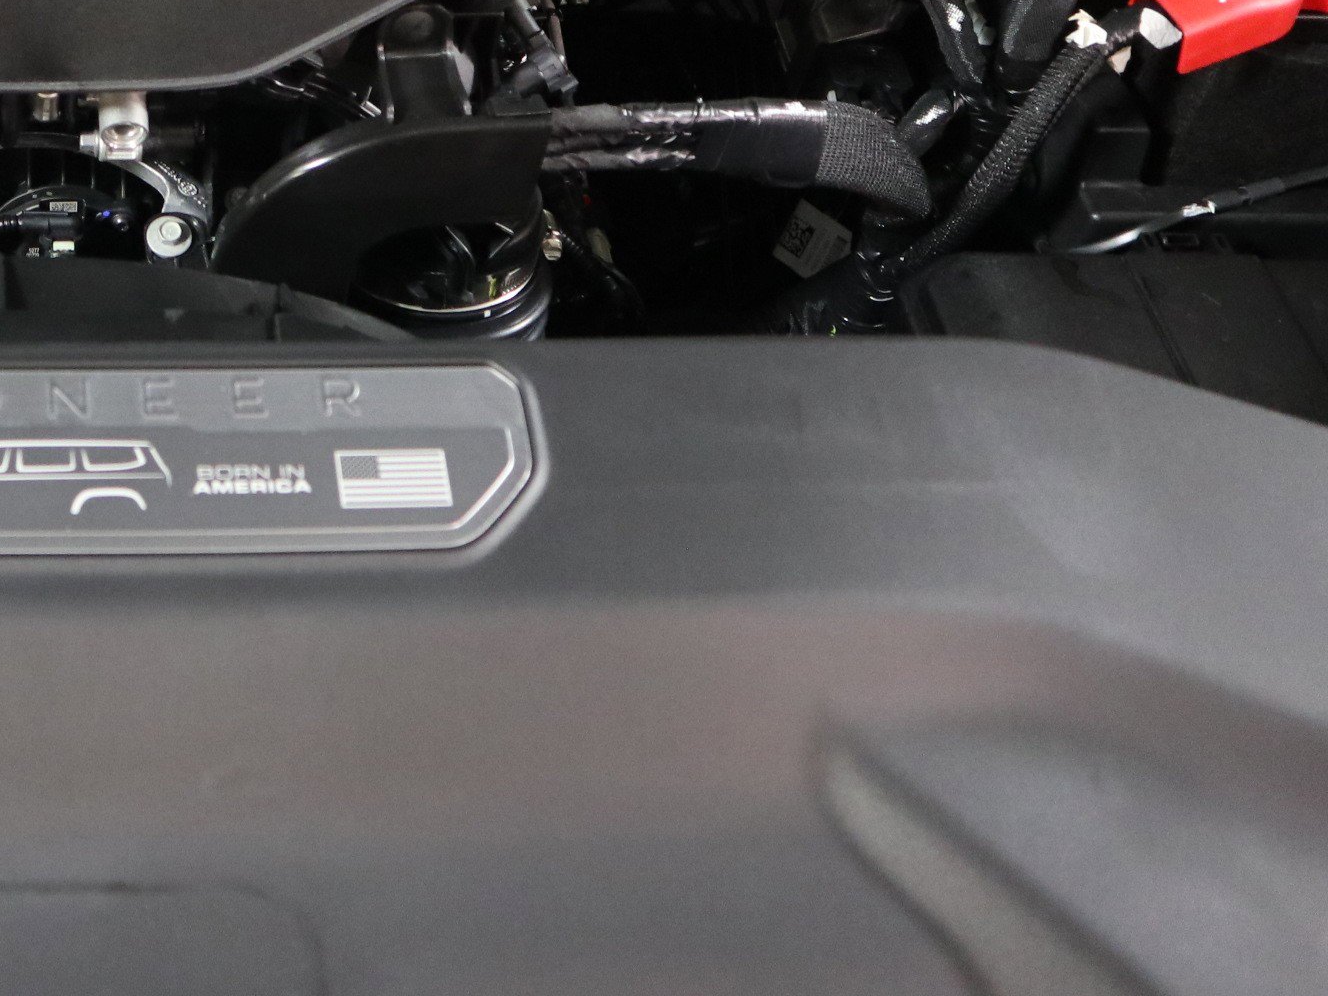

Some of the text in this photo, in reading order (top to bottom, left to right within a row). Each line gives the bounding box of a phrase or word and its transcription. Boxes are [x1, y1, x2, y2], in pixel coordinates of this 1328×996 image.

[196, 464, 305, 480] BORN IN
[192, 478, 312, 494] AMERICA
